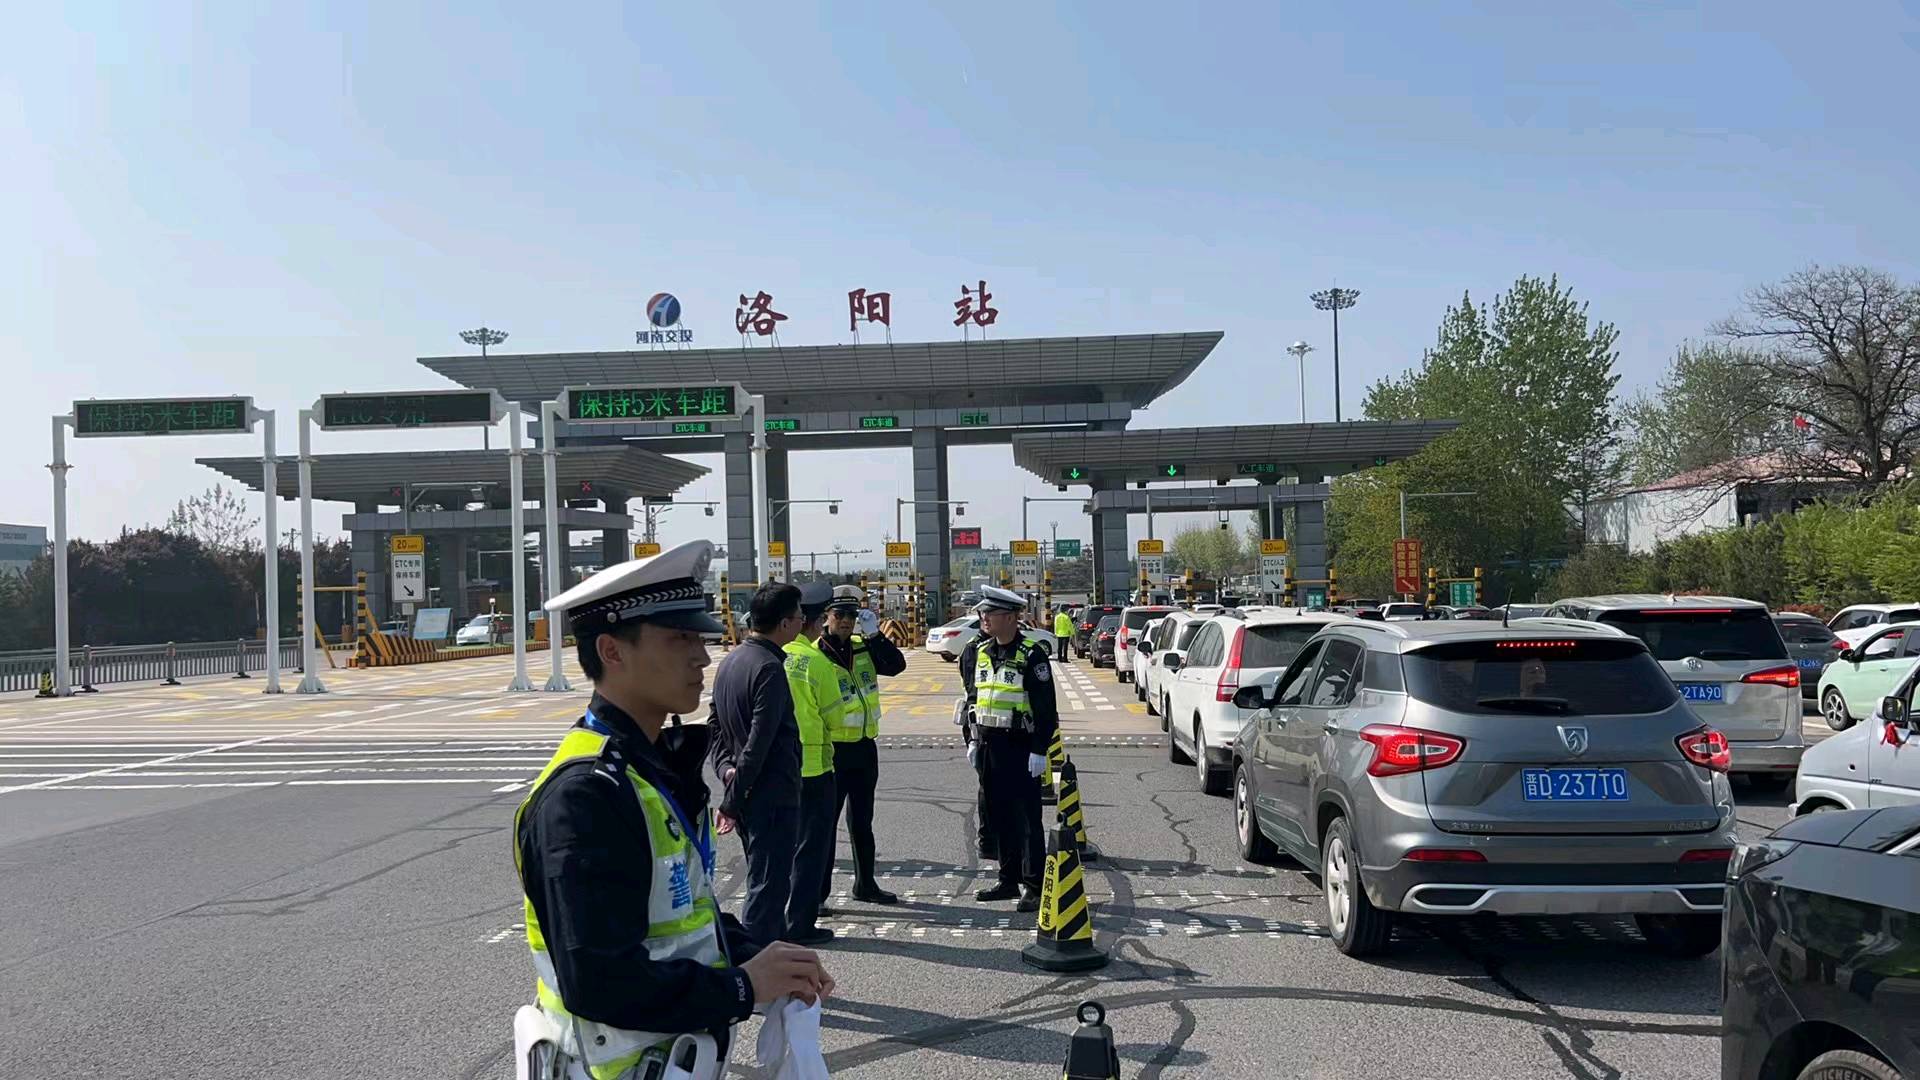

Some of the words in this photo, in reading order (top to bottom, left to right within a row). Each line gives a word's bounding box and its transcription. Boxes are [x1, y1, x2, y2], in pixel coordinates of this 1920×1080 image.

[736, 280, 999, 336] 洛阳站
[636, 329, 693, 344] 河南交投
[88, 402, 237, 432] 保持5米车距
[578, 383, 728, 419] 保持5米车距
